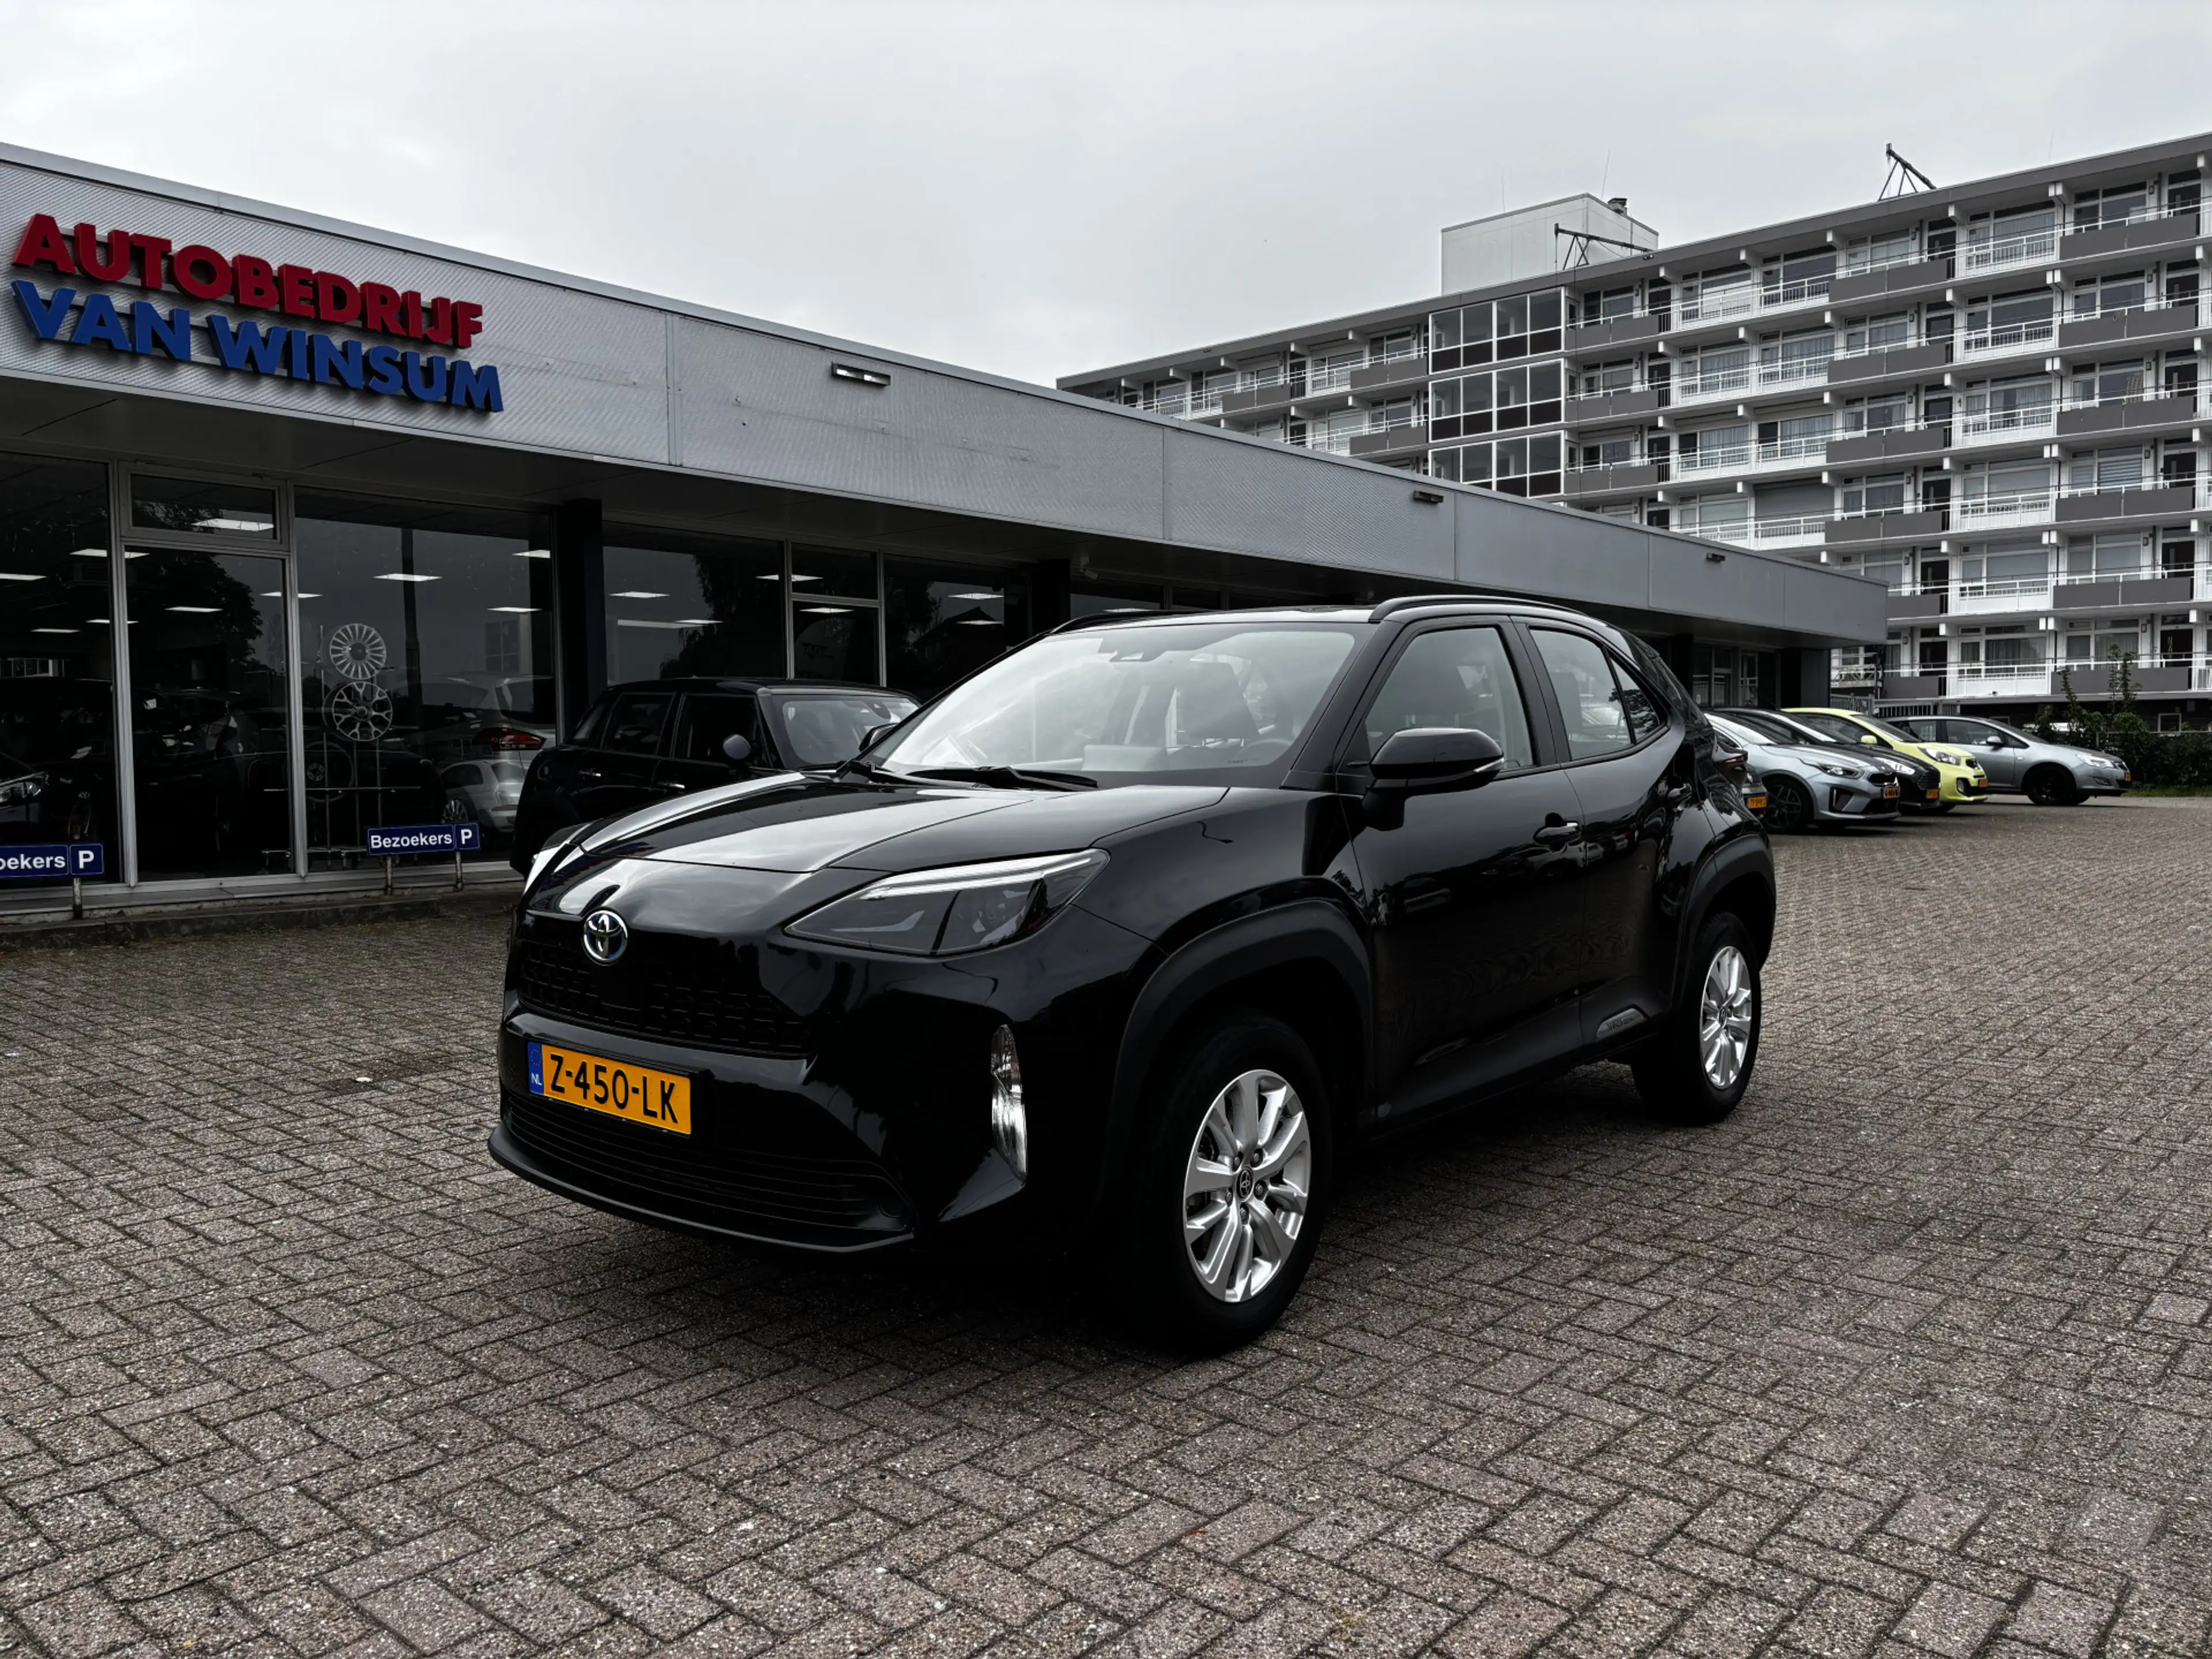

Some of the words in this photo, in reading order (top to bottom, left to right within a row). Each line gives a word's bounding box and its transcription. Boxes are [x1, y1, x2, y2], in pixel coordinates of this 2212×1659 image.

[12, 213, 483, 349] AUTOBEDRIJF
[12, 280, 191, 362] VAN
[206, 314, 504, 412] WINSUM
[78, 850, 94, 869] P
[370, 832, 452, 849] Bezoekers
[460, 829, 472, 844] P
[531, 1072, 542, 1086] NL
[550, 1052, 679, 1124] Z-450-LK
